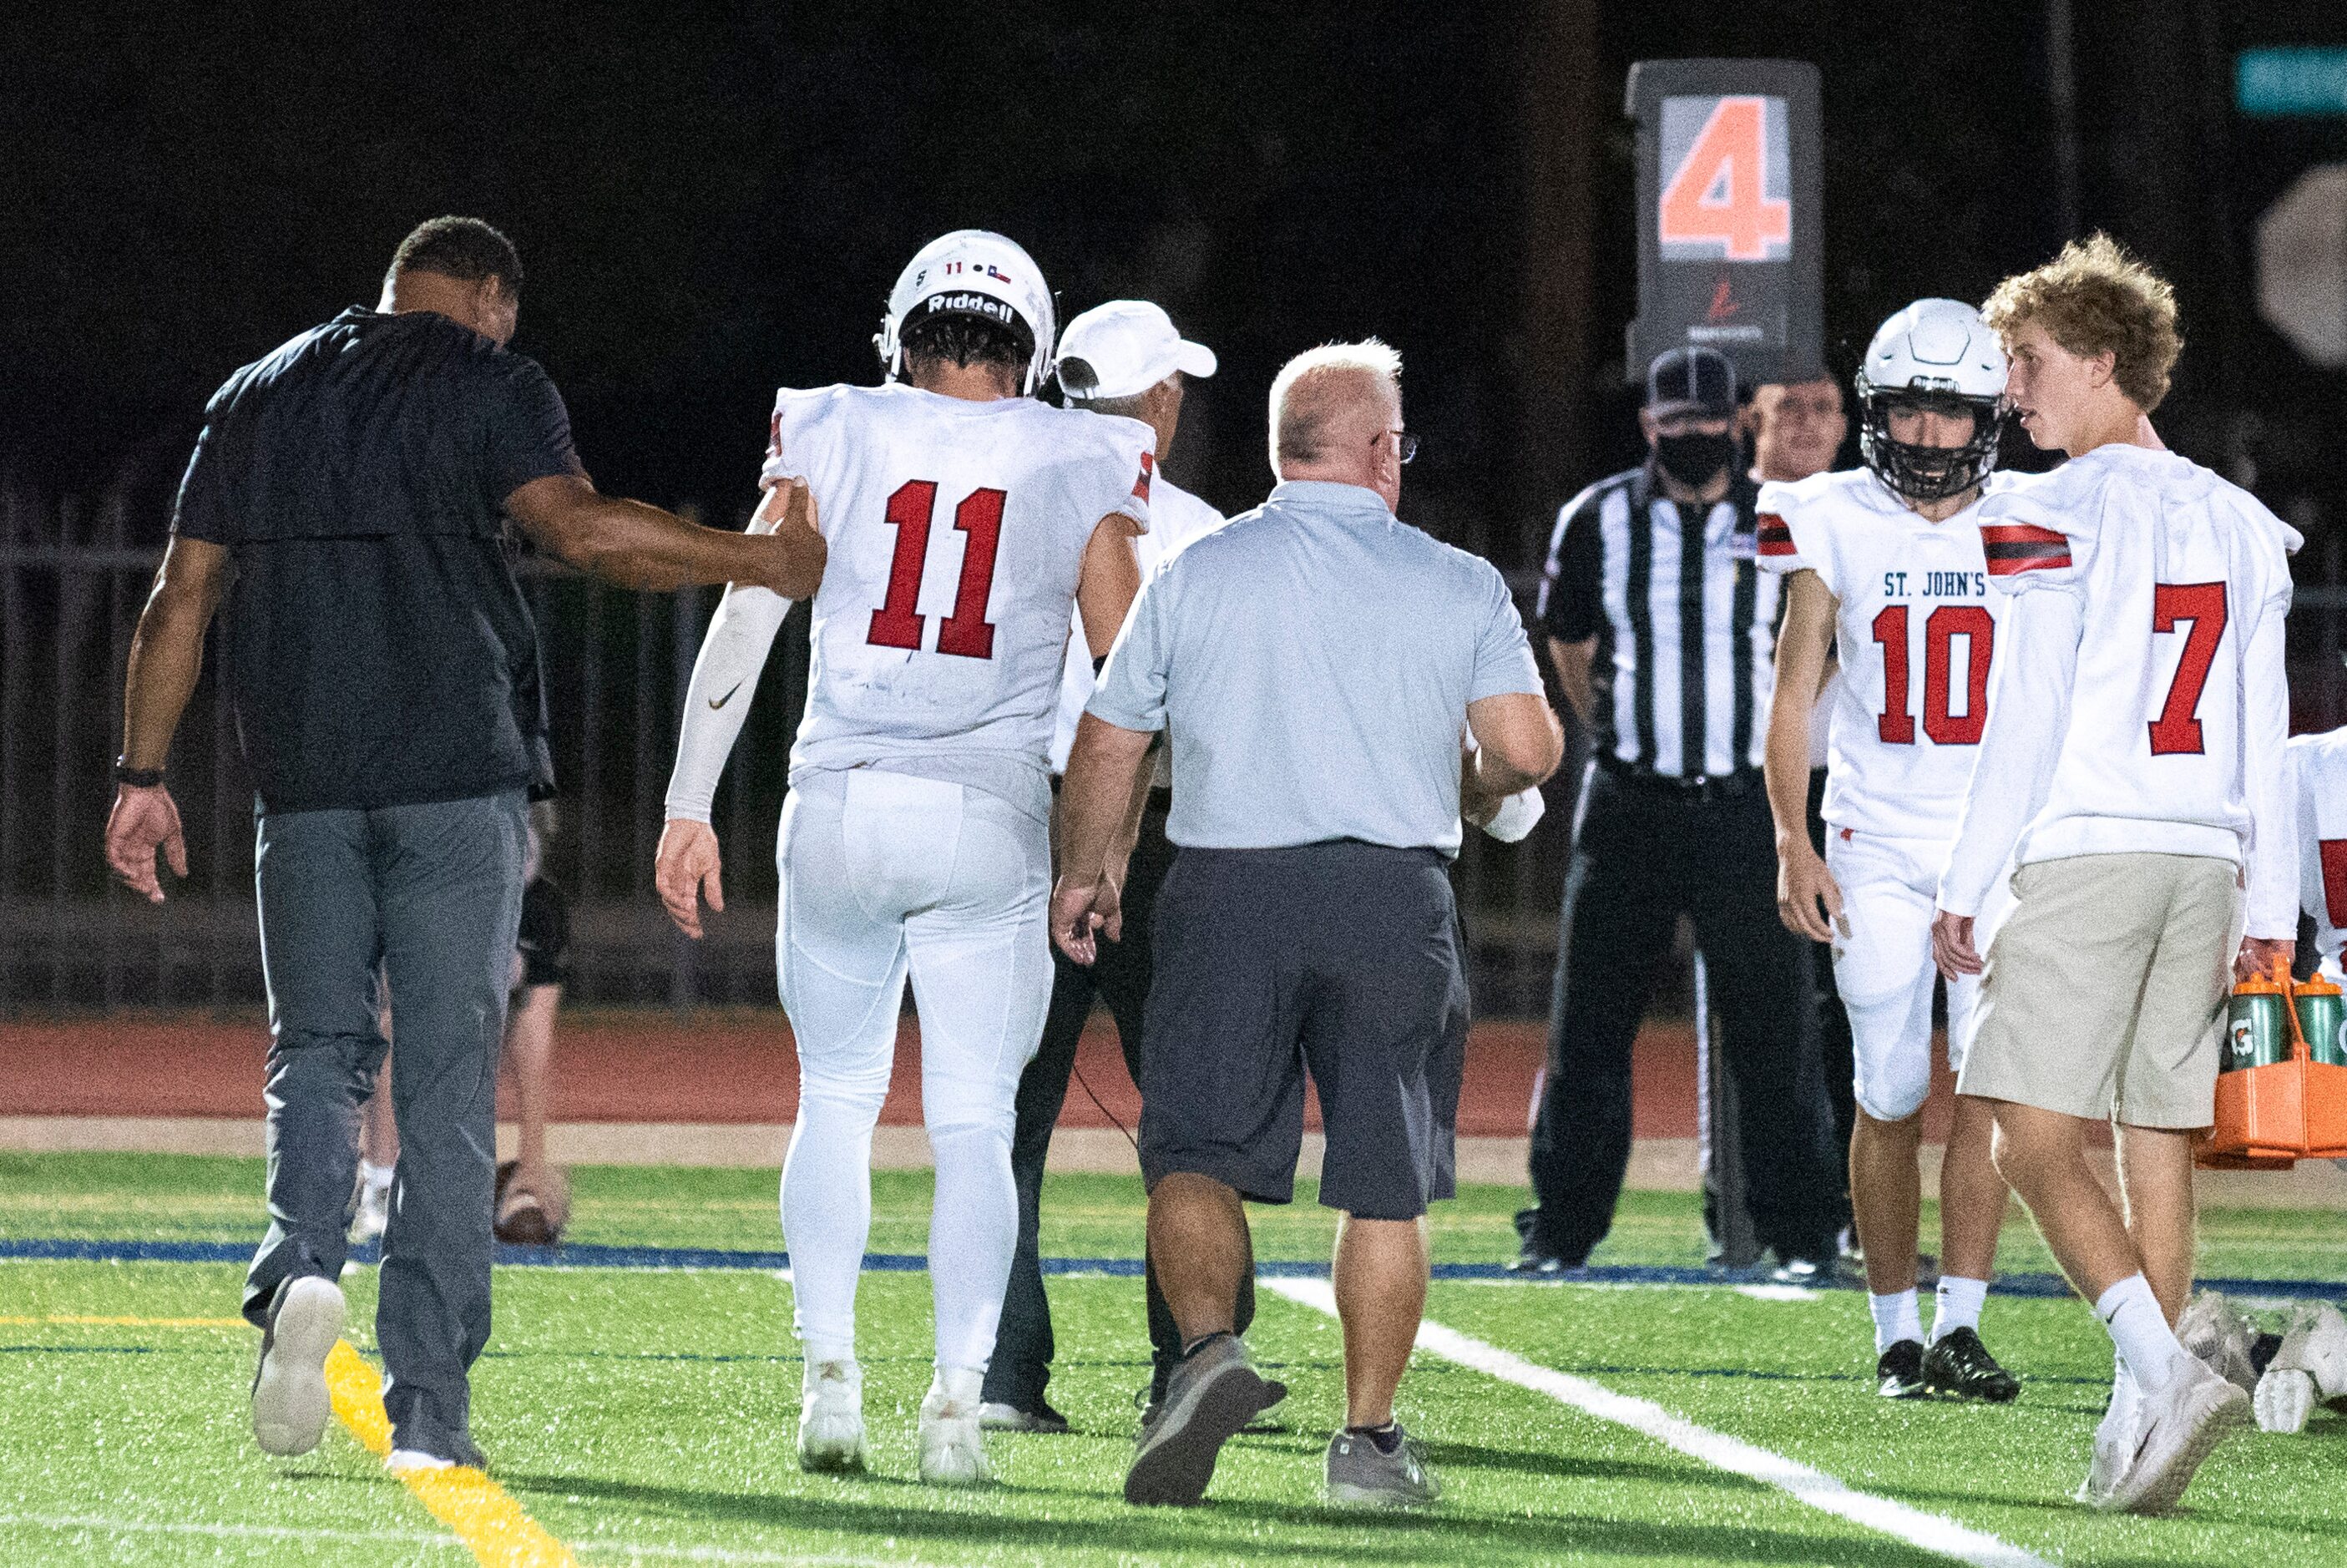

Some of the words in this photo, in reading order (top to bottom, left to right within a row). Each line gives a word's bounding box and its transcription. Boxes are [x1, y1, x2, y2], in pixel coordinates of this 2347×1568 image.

[1659, 95, 1791, 260] 4
[928, 293, 1014, 323] Riddell
[946, 261, 962, 275] 11
[866, 479, 1008, 660] 11
[1884, 572, 1912, 596] ST.
[1922, 572, 1986, 596] JOHN'S
[1872, 604, 1995, 745] 10
[2147, 581, 2228, 756] 7
